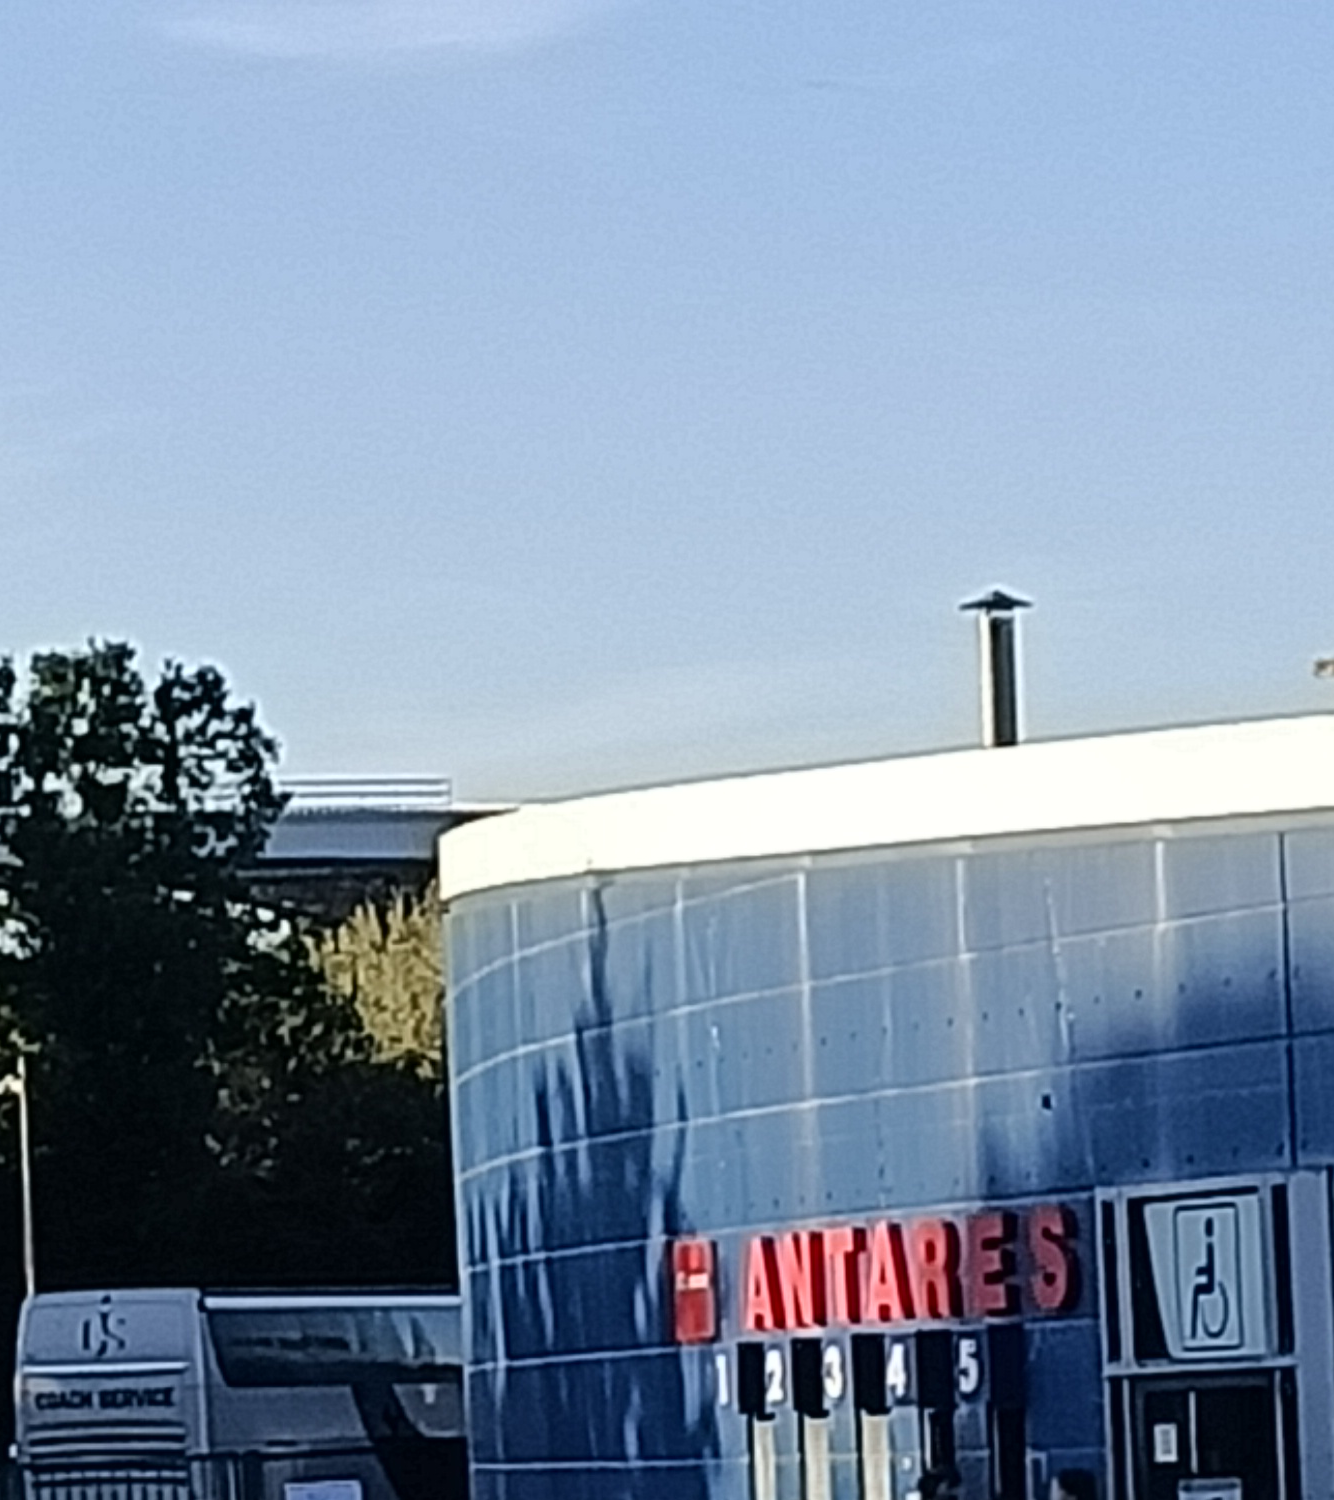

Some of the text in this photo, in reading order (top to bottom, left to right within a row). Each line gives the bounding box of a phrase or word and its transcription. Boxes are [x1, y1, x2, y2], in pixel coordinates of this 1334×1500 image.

[746, 1204, 1073, 1331] ANTARES
[98, 1387, 176, 1410] SERVICE
[715, 1338, 980, 1406] 1 2 3 4 5
